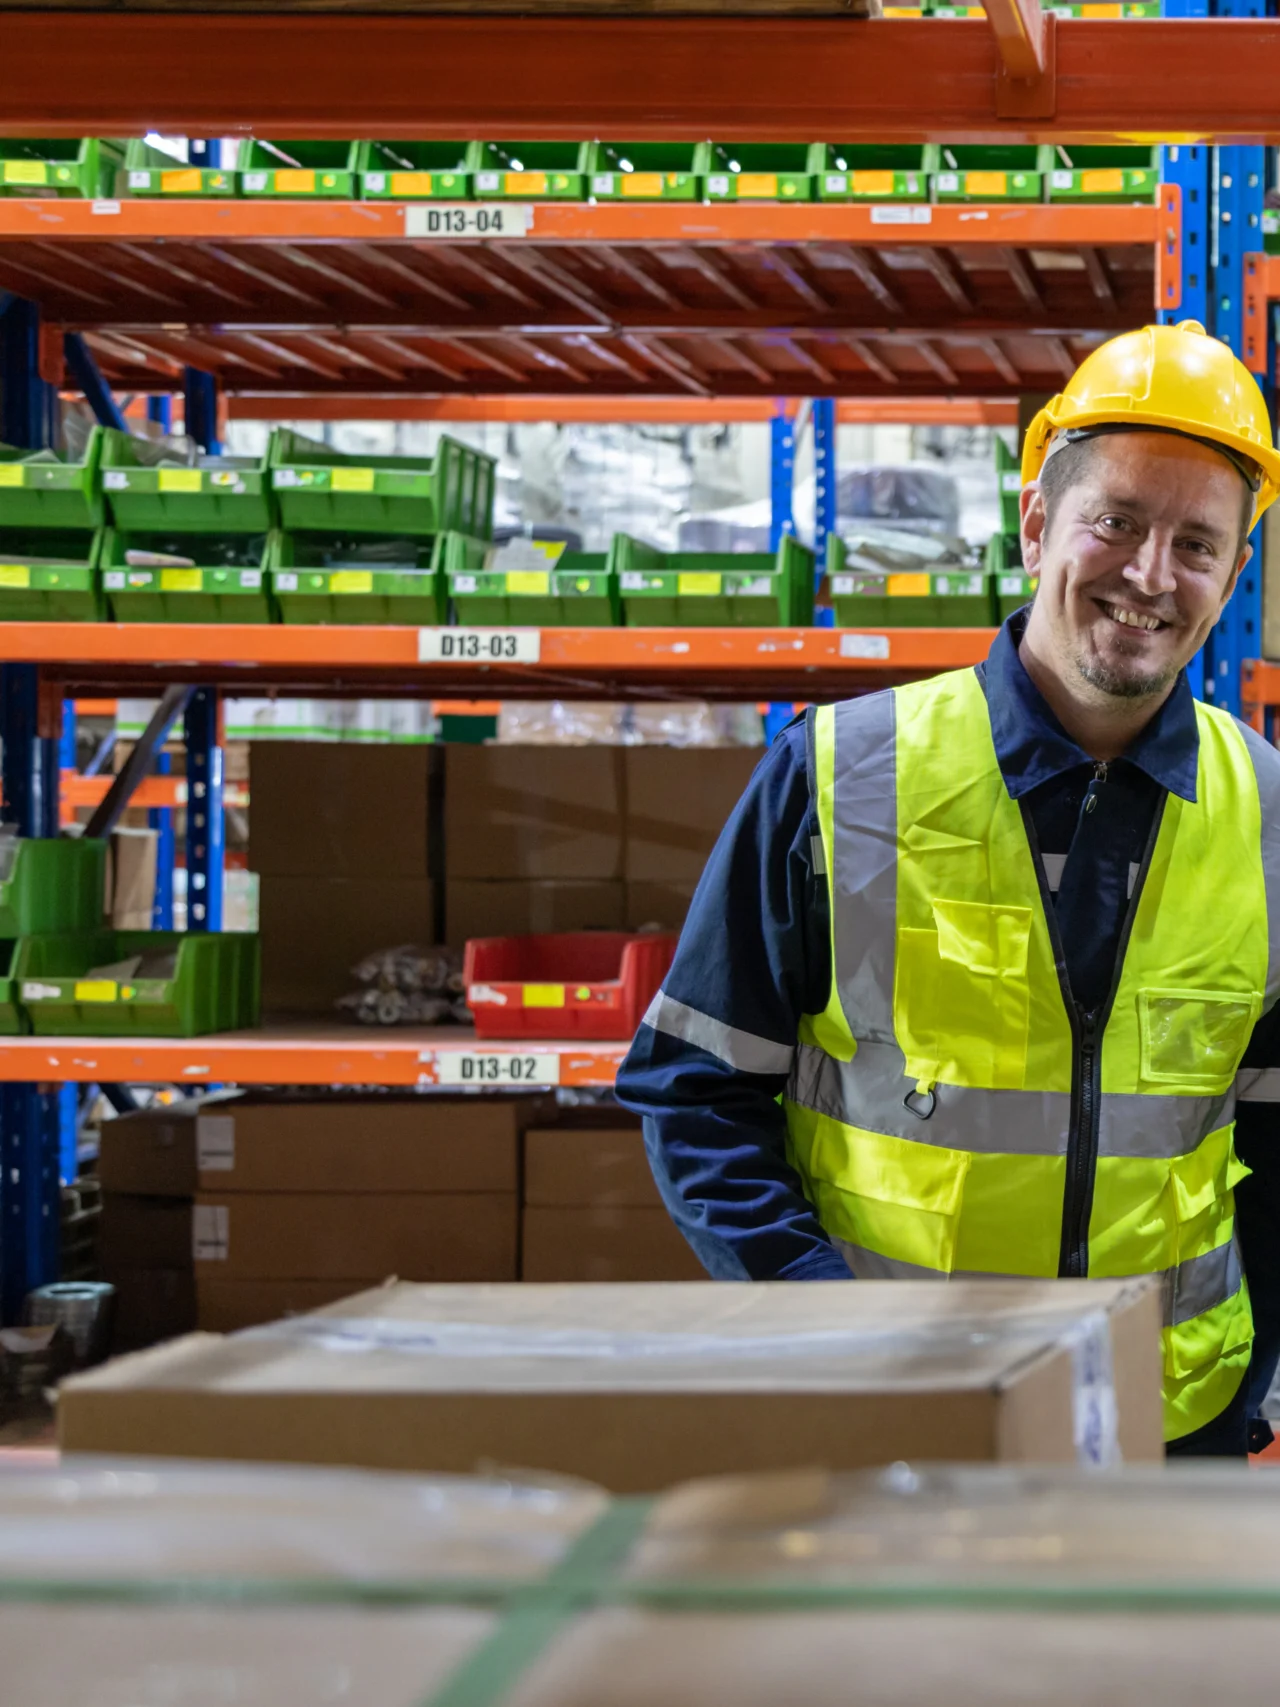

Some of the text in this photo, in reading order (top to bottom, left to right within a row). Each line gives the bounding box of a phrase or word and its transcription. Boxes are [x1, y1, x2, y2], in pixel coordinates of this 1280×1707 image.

[428, 210, 504, 232] D13-04
[441, 634, 519, 657] D13-03
[460, 1057, 538, 1080] D13-02
